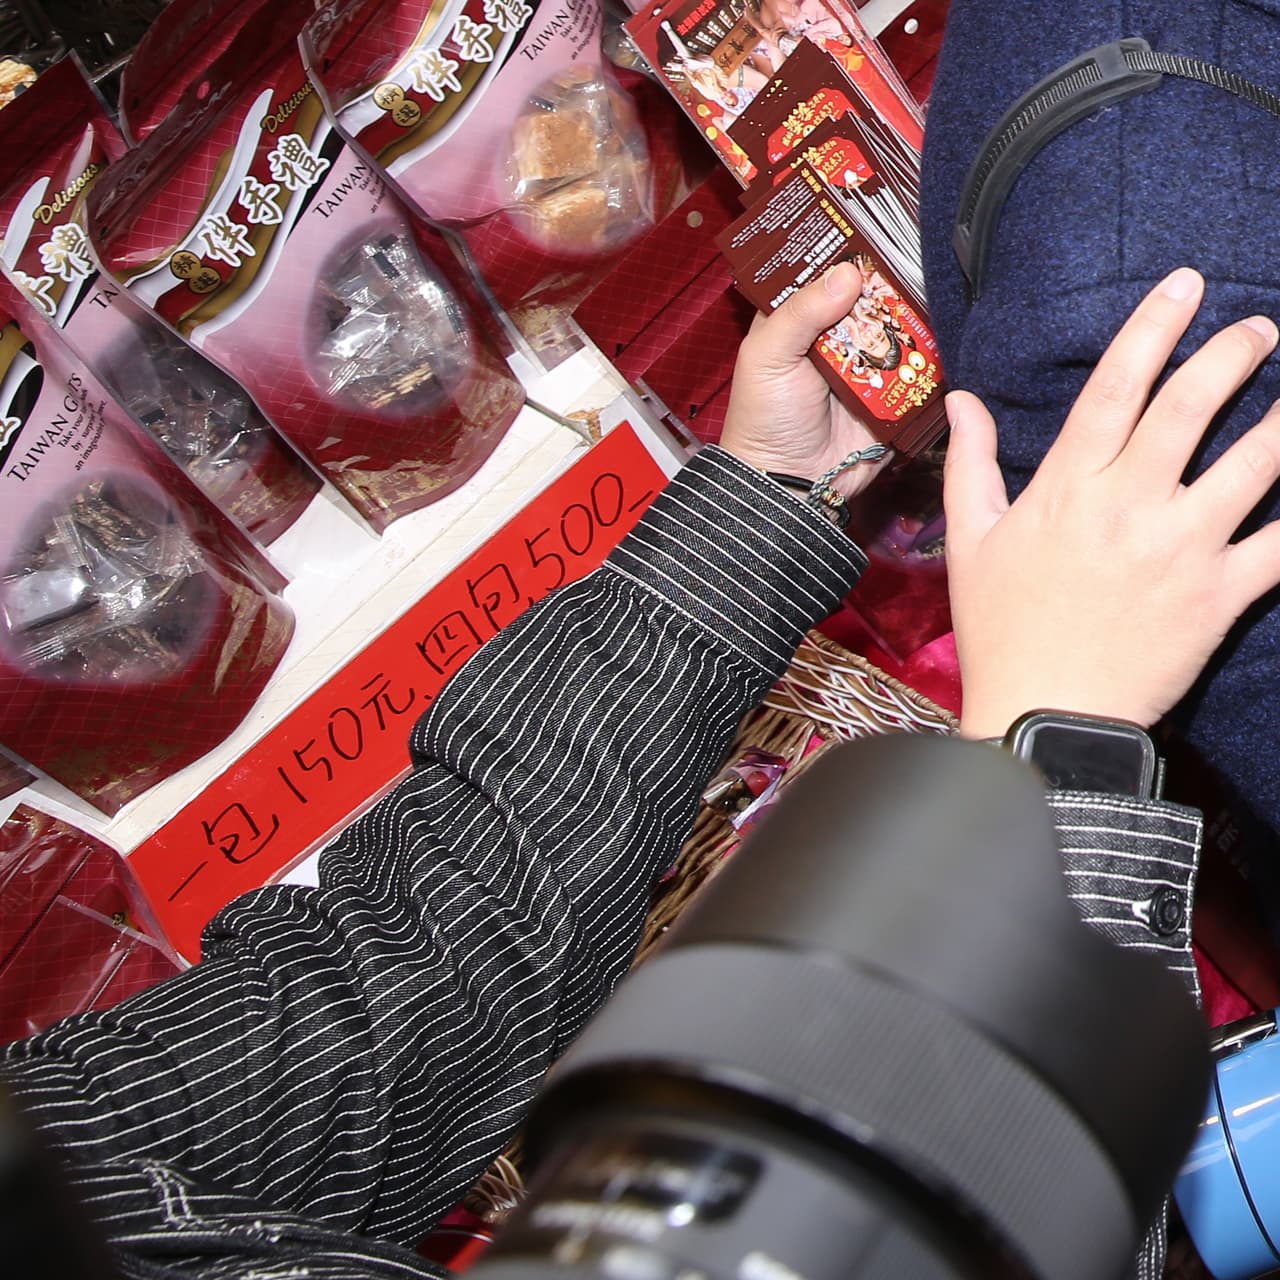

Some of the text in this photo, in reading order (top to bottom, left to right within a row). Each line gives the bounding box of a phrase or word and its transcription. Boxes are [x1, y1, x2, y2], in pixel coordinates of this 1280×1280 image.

[519, 8, 570, 61] TAIWAN
[32, 163, 100, 225] Delicious
[198, 133, 331, 268] 伴手禮
[311, 160, 368, 218] TAIWAN
[6, 413, 71, 482] TAIWAN
